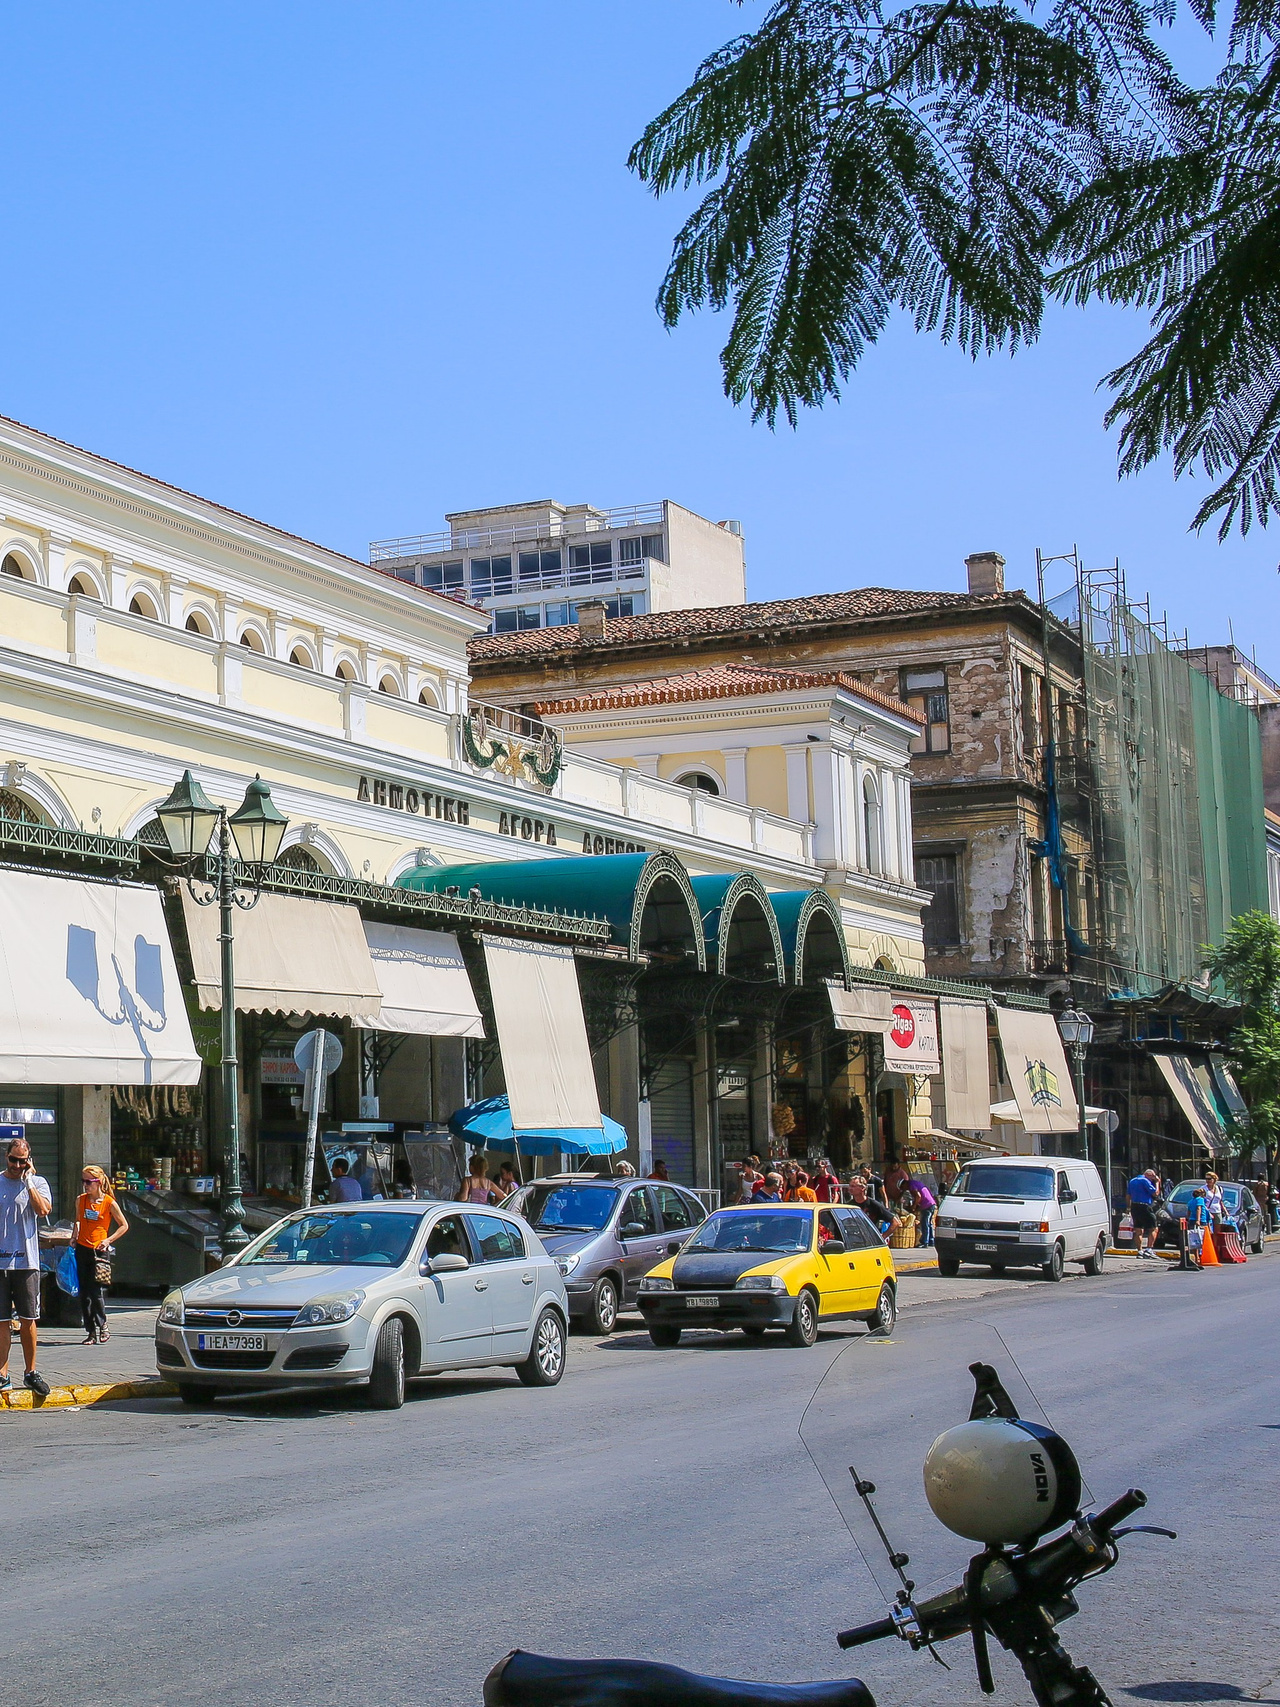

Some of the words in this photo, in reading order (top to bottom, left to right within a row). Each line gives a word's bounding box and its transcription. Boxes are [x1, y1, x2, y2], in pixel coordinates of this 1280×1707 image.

[357, 775, 470, 826] ΔΗΜΟΤΙΚΗ
[498, 811, 558, 846] ΑΓΟΡΑ
[893, 1013, 913, 1035] Rigas
[1030, 1453, 1049, 1502] NOVA
